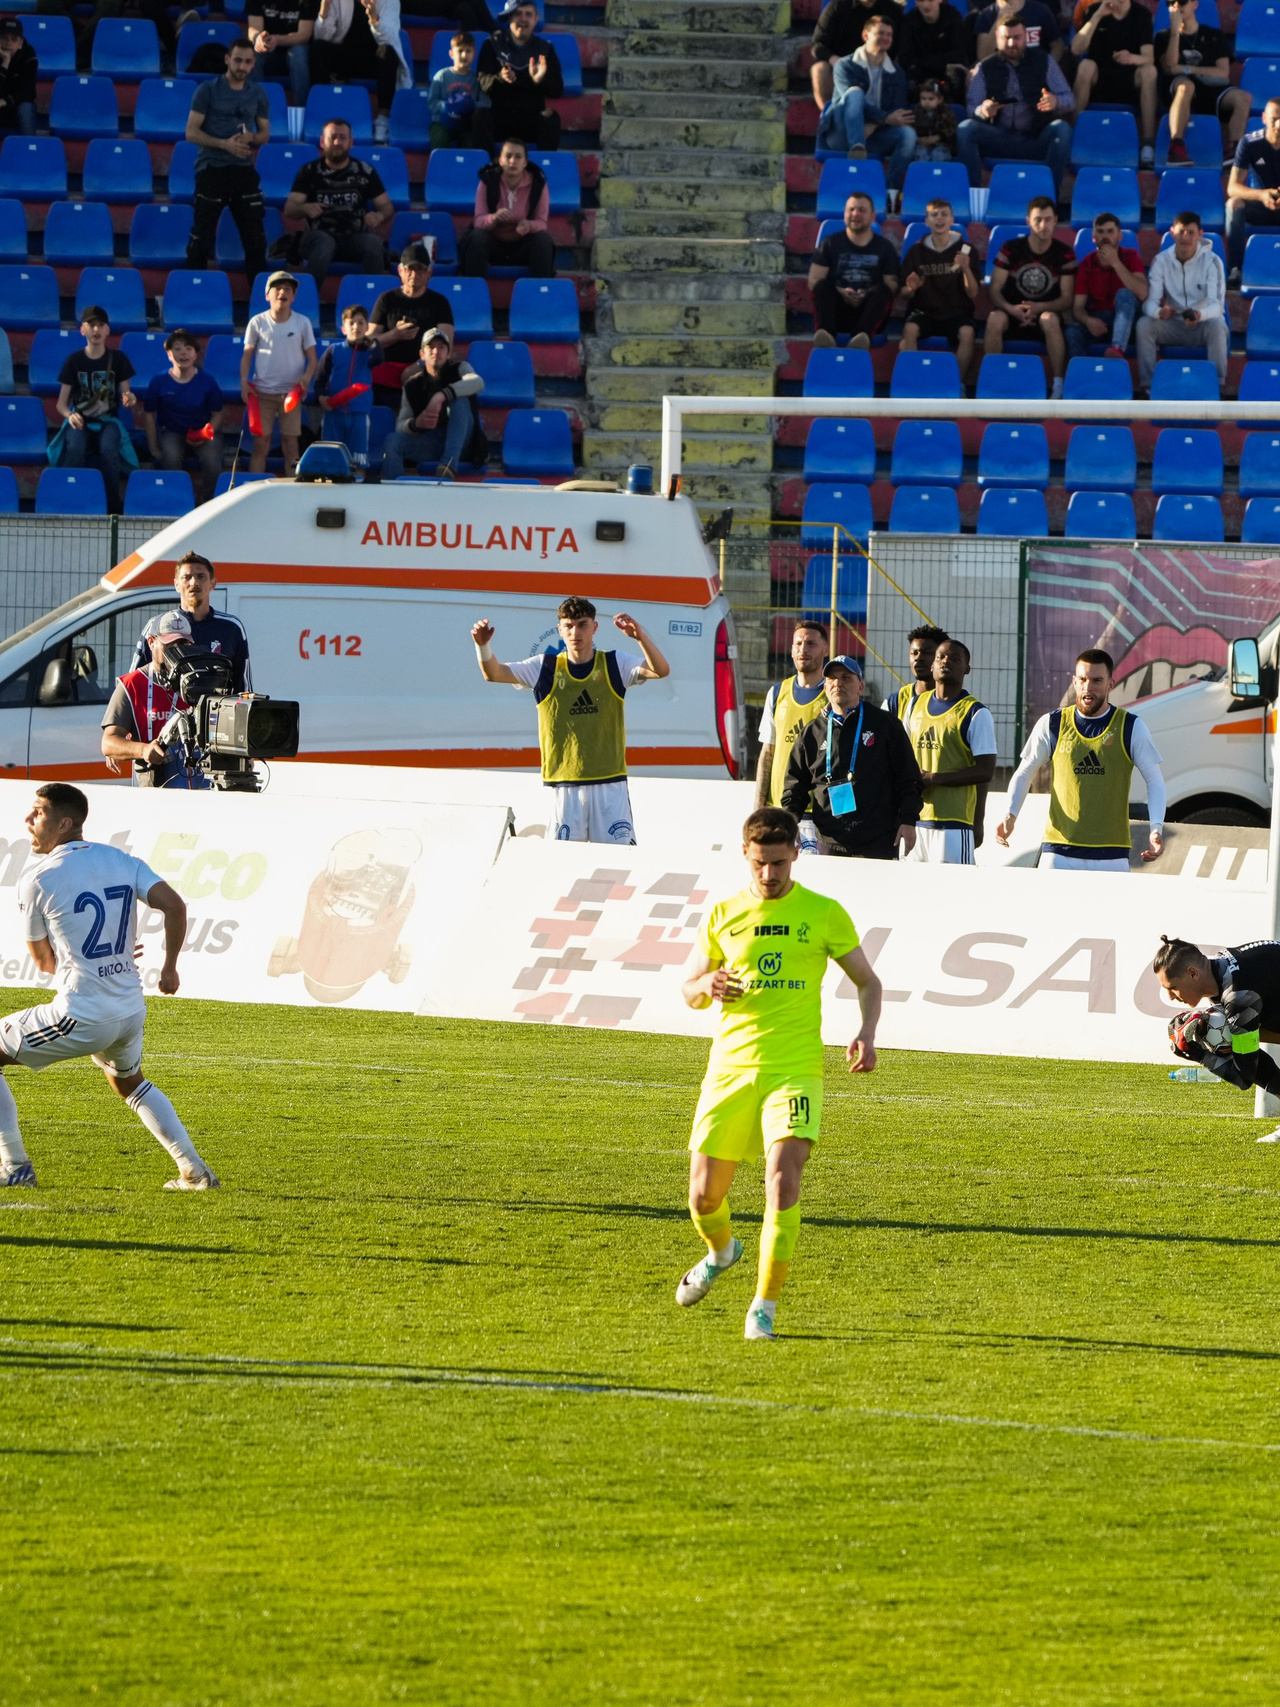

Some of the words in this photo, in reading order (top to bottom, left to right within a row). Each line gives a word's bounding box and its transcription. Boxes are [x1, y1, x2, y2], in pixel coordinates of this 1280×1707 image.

[682, 306, 700, 329] 5
[671, 623, 700, 635] B1/B2
[314, 634, 362, 656] 112
[569, 704, 599, 716] adidas
[1074, 763, 1106, 775] adidas
[150, 832, 268, 901] Eco
[73, 884, 134, 960] 27
[138, 907, 240, 955] Pus
[755, 925, 790, 936] IASI
[788, 980, 807, 990] BET
[788, 1096, 810, 1129] 27
